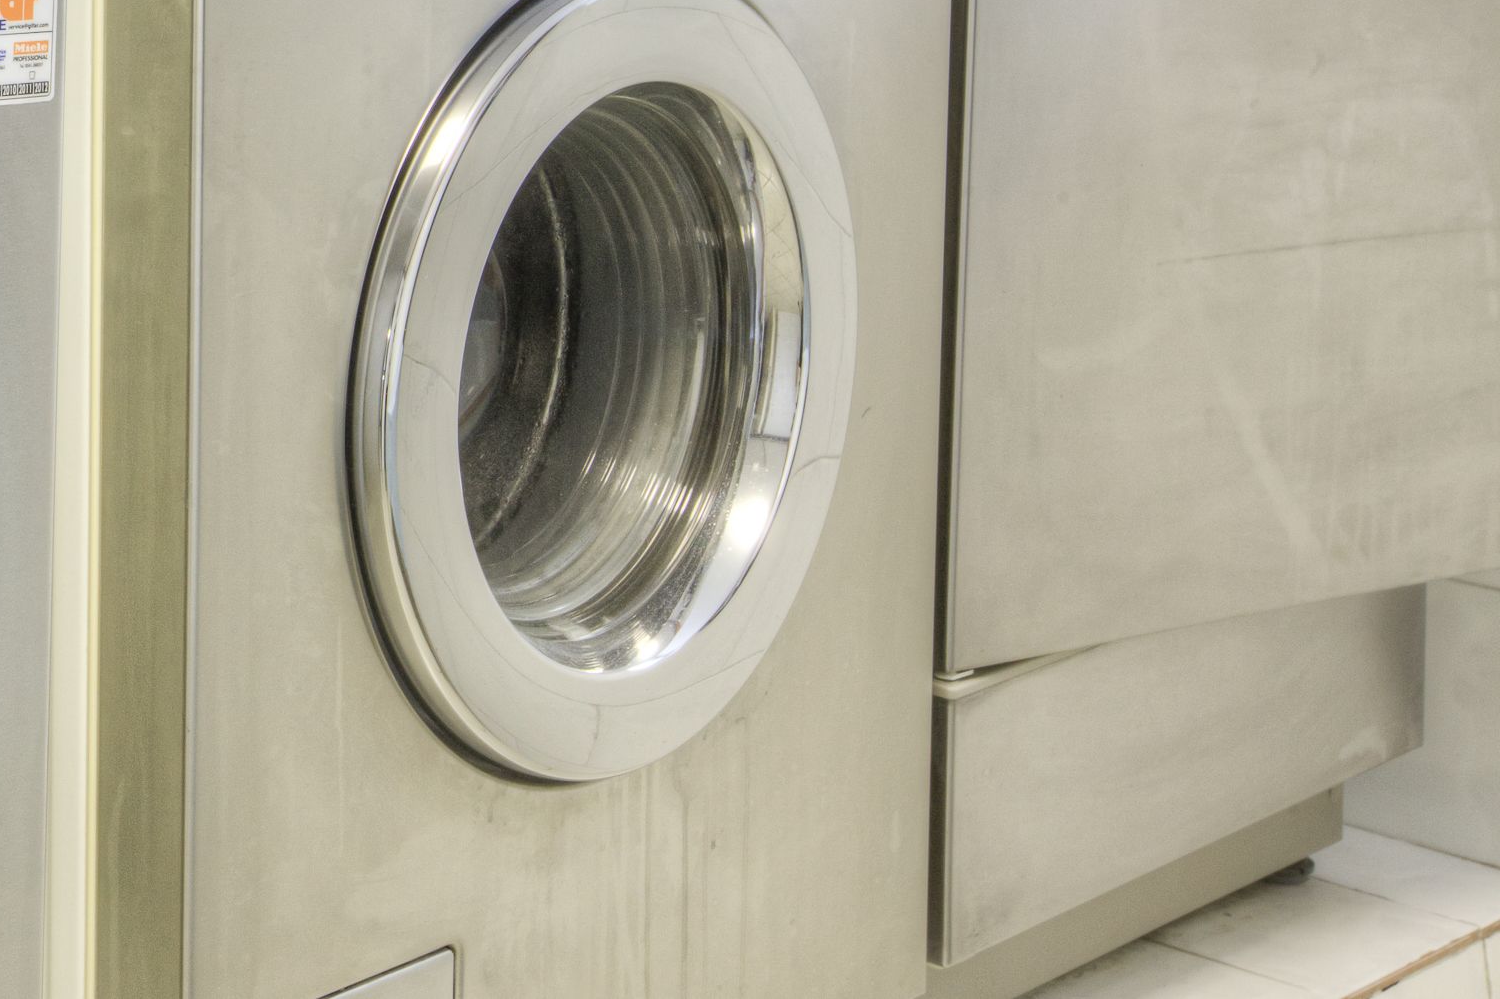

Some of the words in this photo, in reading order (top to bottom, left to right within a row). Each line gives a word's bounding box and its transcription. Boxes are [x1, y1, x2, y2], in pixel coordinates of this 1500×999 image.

[15, 42, 48, 54] Miele
[13, 54, 48, 62] PROFESSIONAL
[2, 86, 17, 96] 2010
[19, 84, 32, 94] 2011
[34, 82, 48, 93] 2012
